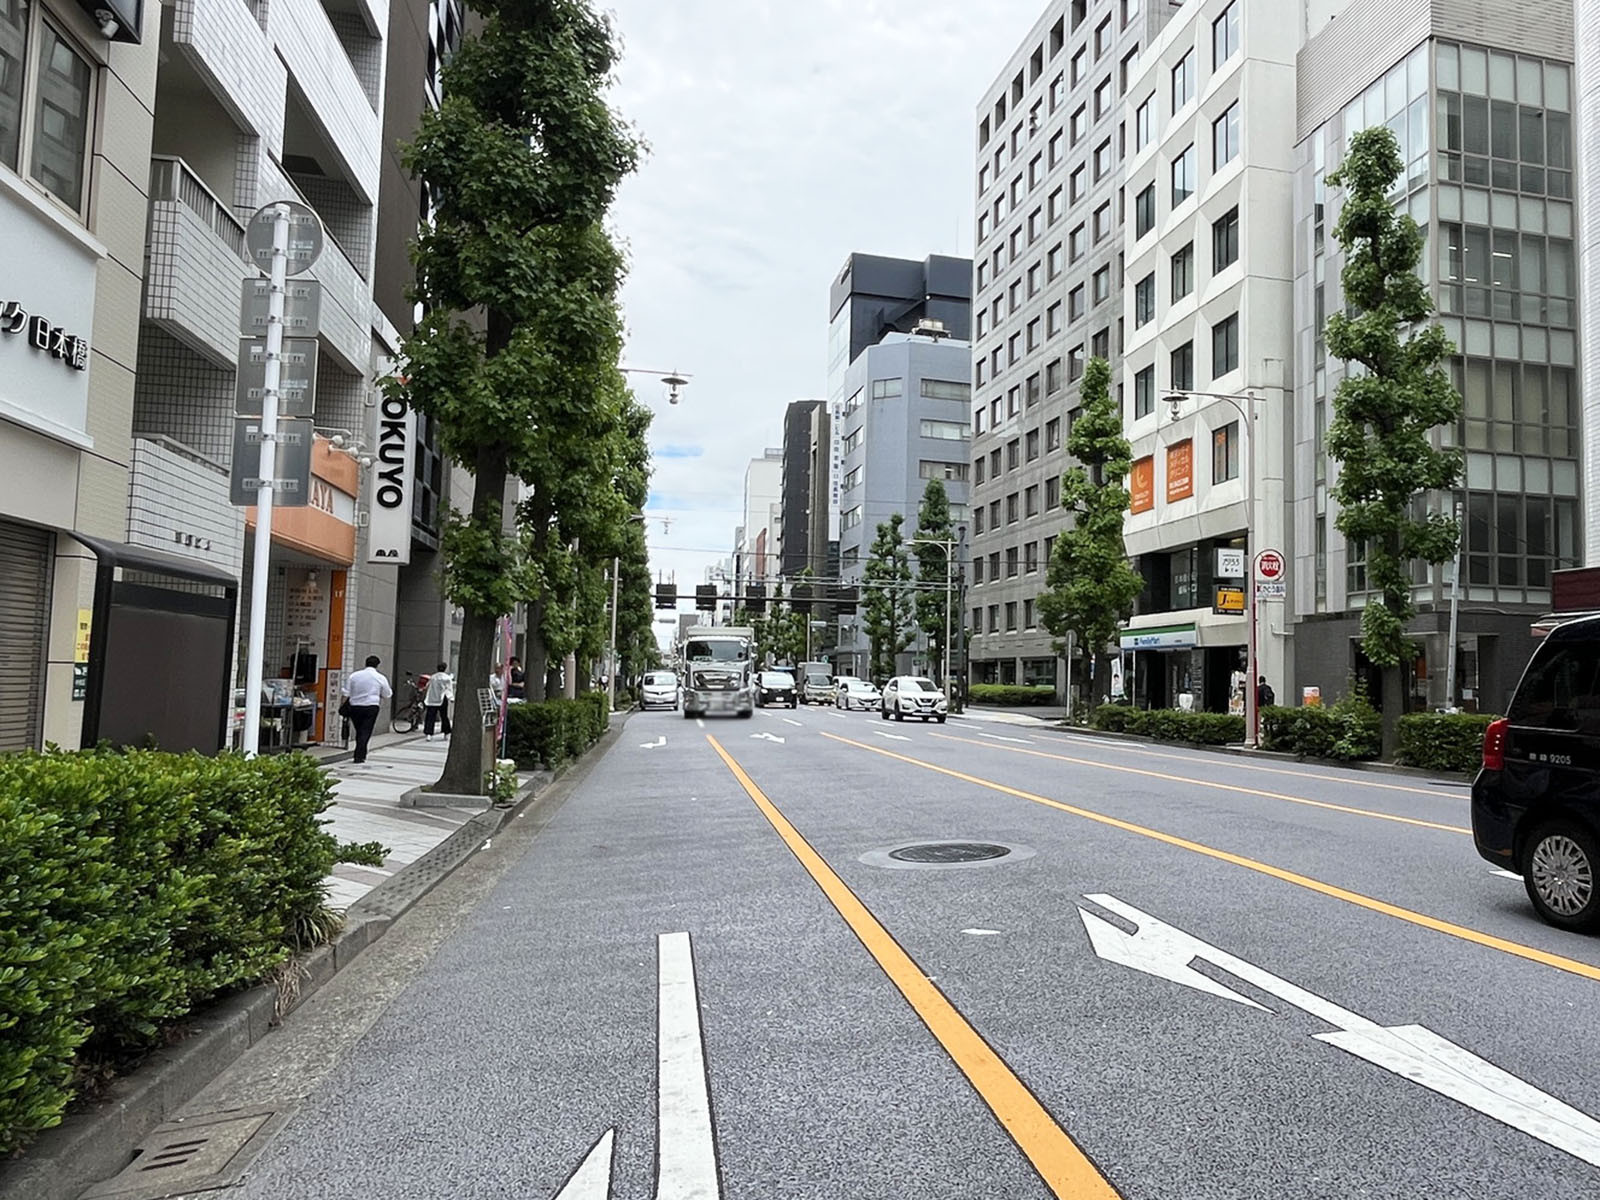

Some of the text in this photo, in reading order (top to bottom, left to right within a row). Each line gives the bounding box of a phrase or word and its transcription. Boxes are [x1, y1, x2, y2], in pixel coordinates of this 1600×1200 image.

[0, 301, 87, 370] ク日本橋
[376, 395, 407, 508] OKUYO
[1550, 754, 1571, 765] 9205
